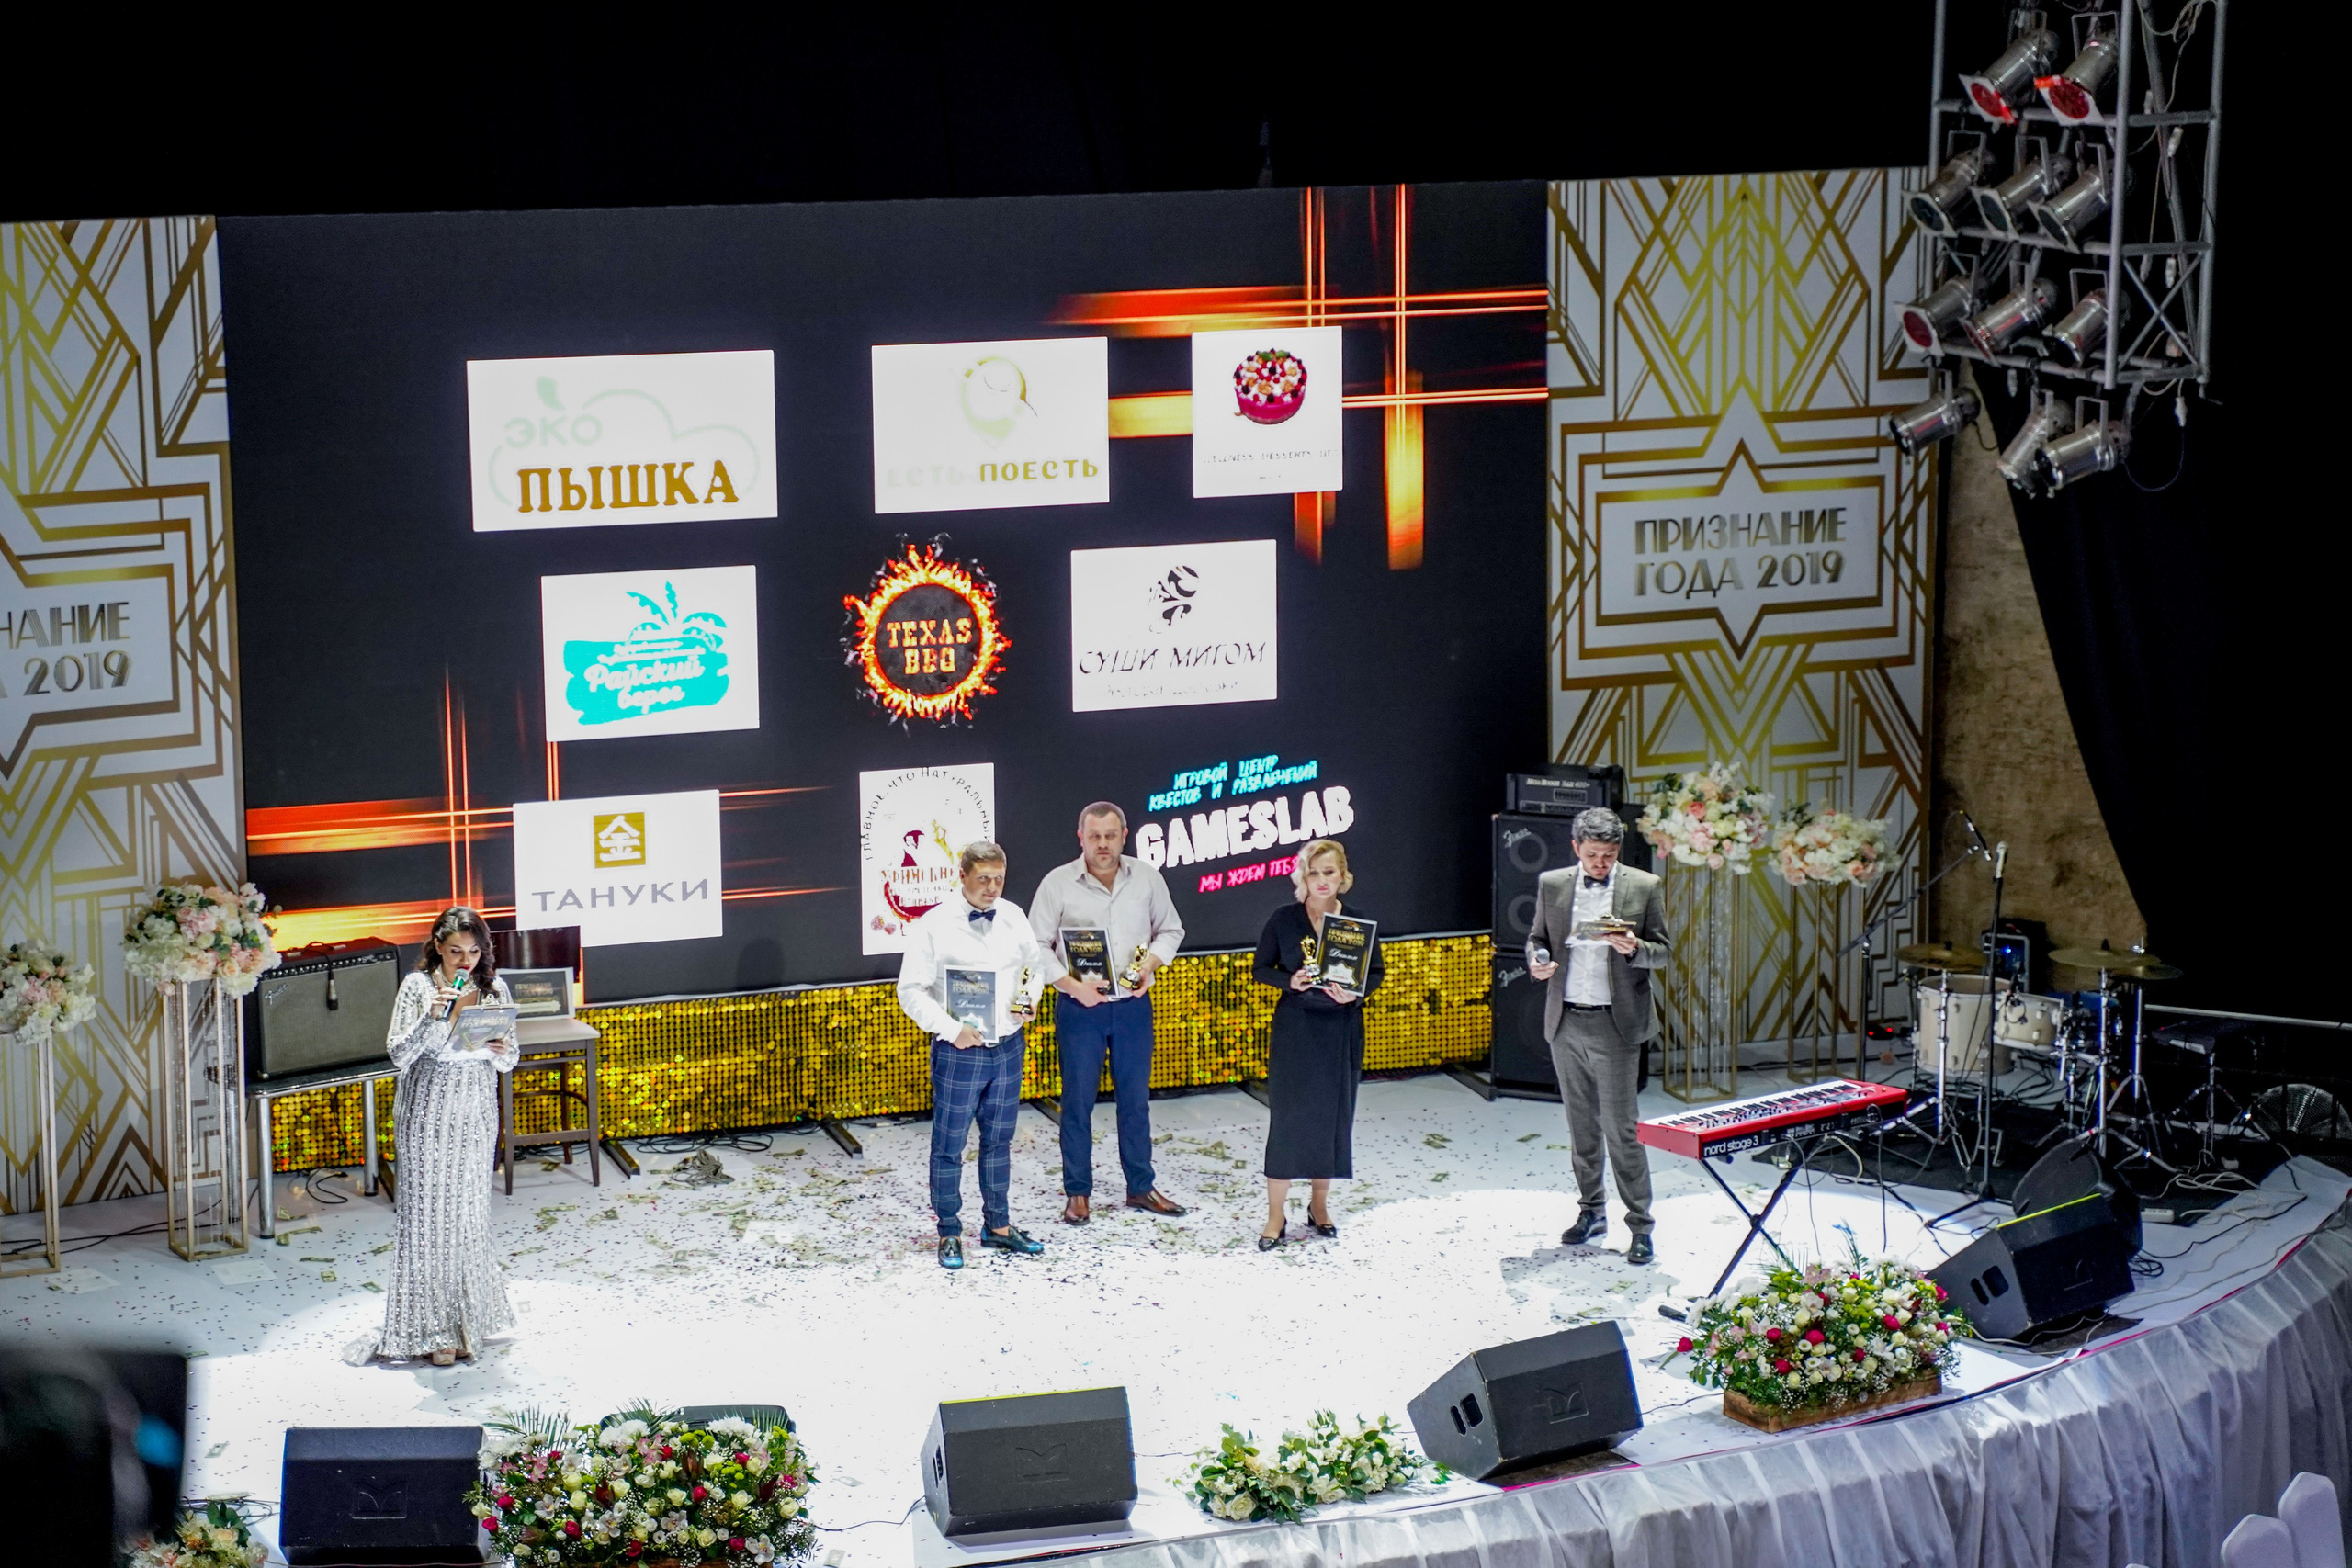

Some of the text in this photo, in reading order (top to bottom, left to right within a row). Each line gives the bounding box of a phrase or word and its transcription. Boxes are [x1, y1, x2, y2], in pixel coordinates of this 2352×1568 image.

[504, 414, 603, 448] ЭКО
[516, 459, 740, 513] ПЫШКА
[979, 458, 1099, 483] ПОЕСТЬ
[1634, 507, 1848, 554] ПРИЗНАНИЕ
[1634, 549, 1846, 600] ГОДА 2019
[886, 617, 973, 649] TEXAS
[23, 649, 133, 697] 2019
[583, 653, 706, 693] Райский
[904, 647, 956, 675] BBQ
[1079, 641, 1267, 674] СУШИ МИГОМ
[888, 772, 915, 789] ЧТО
[1148, 760, 1319, 812] КВЕСТОВ И РАЗВЛЕЧЕНИЙ
[1173, 754, 1279, 791] ИГРОВОЙ ЦЕНТР
[1136, 785, 1354, 871] GAMESLAB
[531, 878, 708, 912] ТАНУКИ
[1198, 873, 1224, 894] МЫ
[1226, 862, 1267, 888] ЖДЕМ
[1703, 1134, 1759, 1156] nord stage 3
